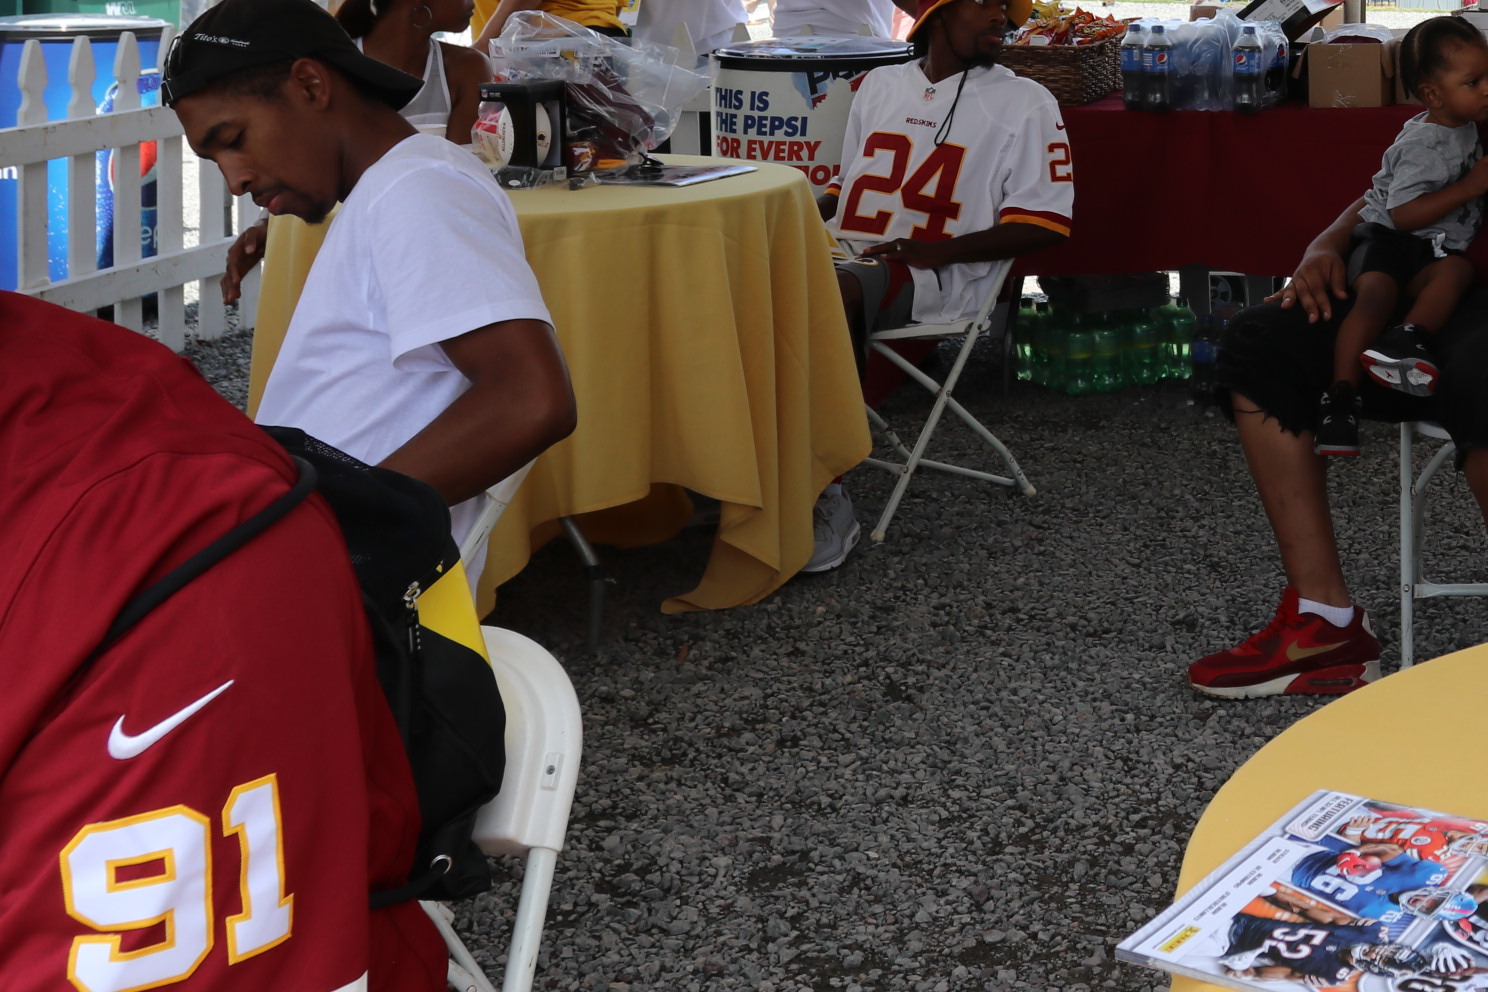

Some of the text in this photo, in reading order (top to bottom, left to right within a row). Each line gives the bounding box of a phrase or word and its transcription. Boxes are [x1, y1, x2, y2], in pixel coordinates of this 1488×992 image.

[194, 33, 218, 43] Tito's
[715, 87, 769, 112] THIS IS
[716, 111, 808, 137] THE PEPSI
[905, 117, 937, 128] REDSKINS
[716, 136, 821, 162] FOR EVERY
[840, 131, 967, 242] 24
[59, 773, 294, 992] 91
